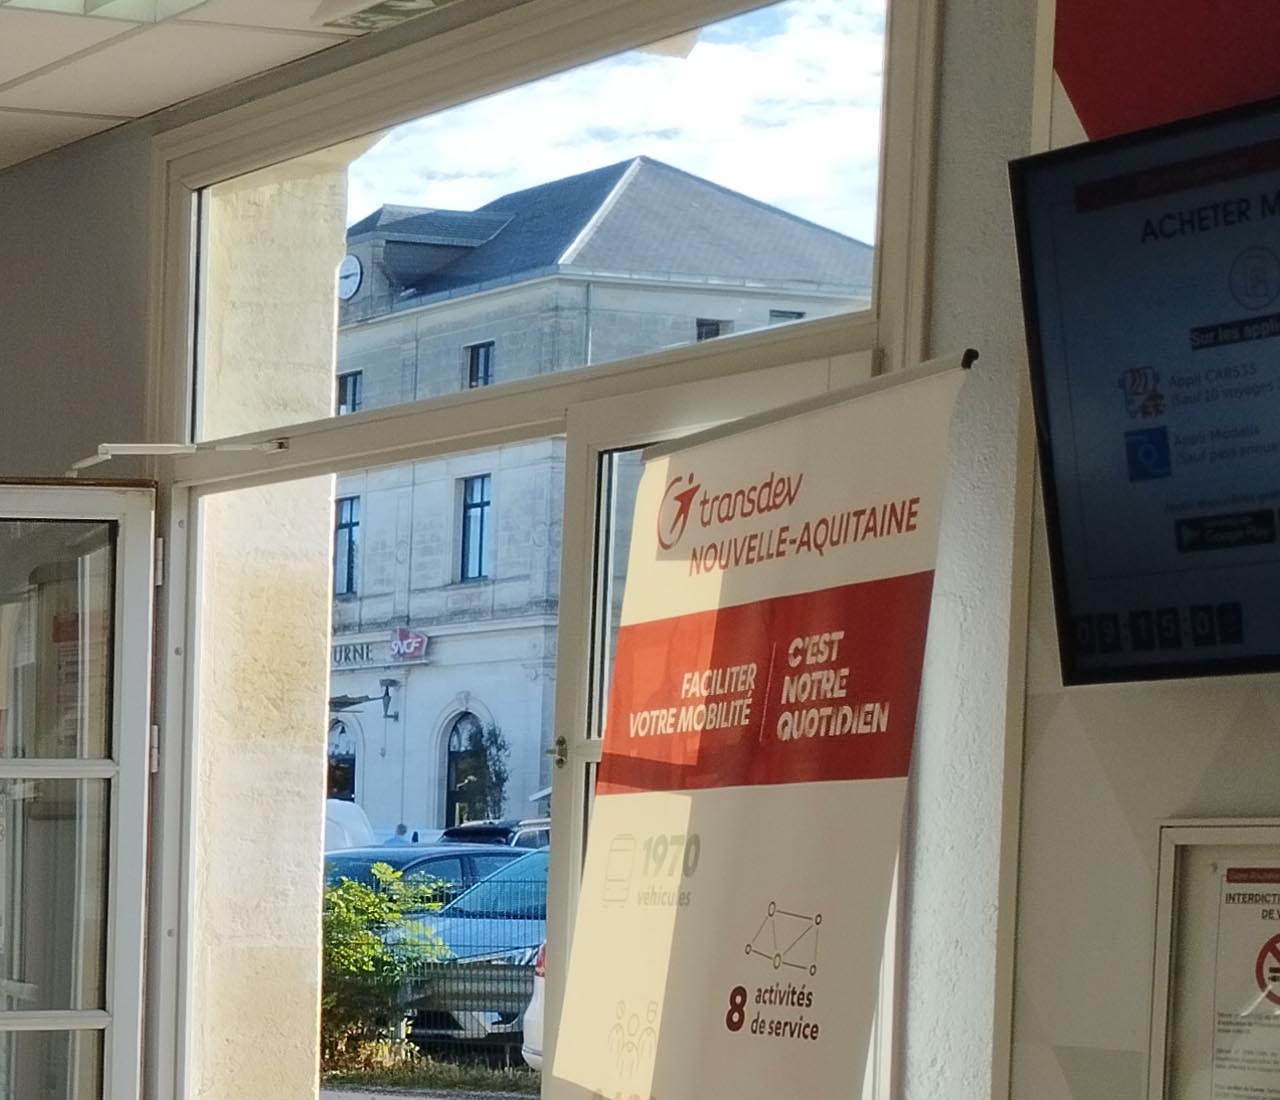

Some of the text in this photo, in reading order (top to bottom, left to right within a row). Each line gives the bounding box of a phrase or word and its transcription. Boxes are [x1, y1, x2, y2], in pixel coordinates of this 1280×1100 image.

[1141, 198, 1251, 243] ACHETER
[700, 471, 803, 528] transdev
[689, 497, 920, 576] NOUVELLE-AQUITAINE
[391, 638, 421, 655] SNCF
[788, 630, 845, 668] C'EST
[681, 663, 757, 698] FACILITER
[780, 667, 849, 705] NOTRE
[629, 689, 752, 738] VOTRE MOBILITÉ
[776, 702, 889, 741] QUOTIDIEN
[642, 833, 701, 878] 1970
[726, 982, 813, 1032] 8 activités
[750, 1011, 819, 1040] de service
